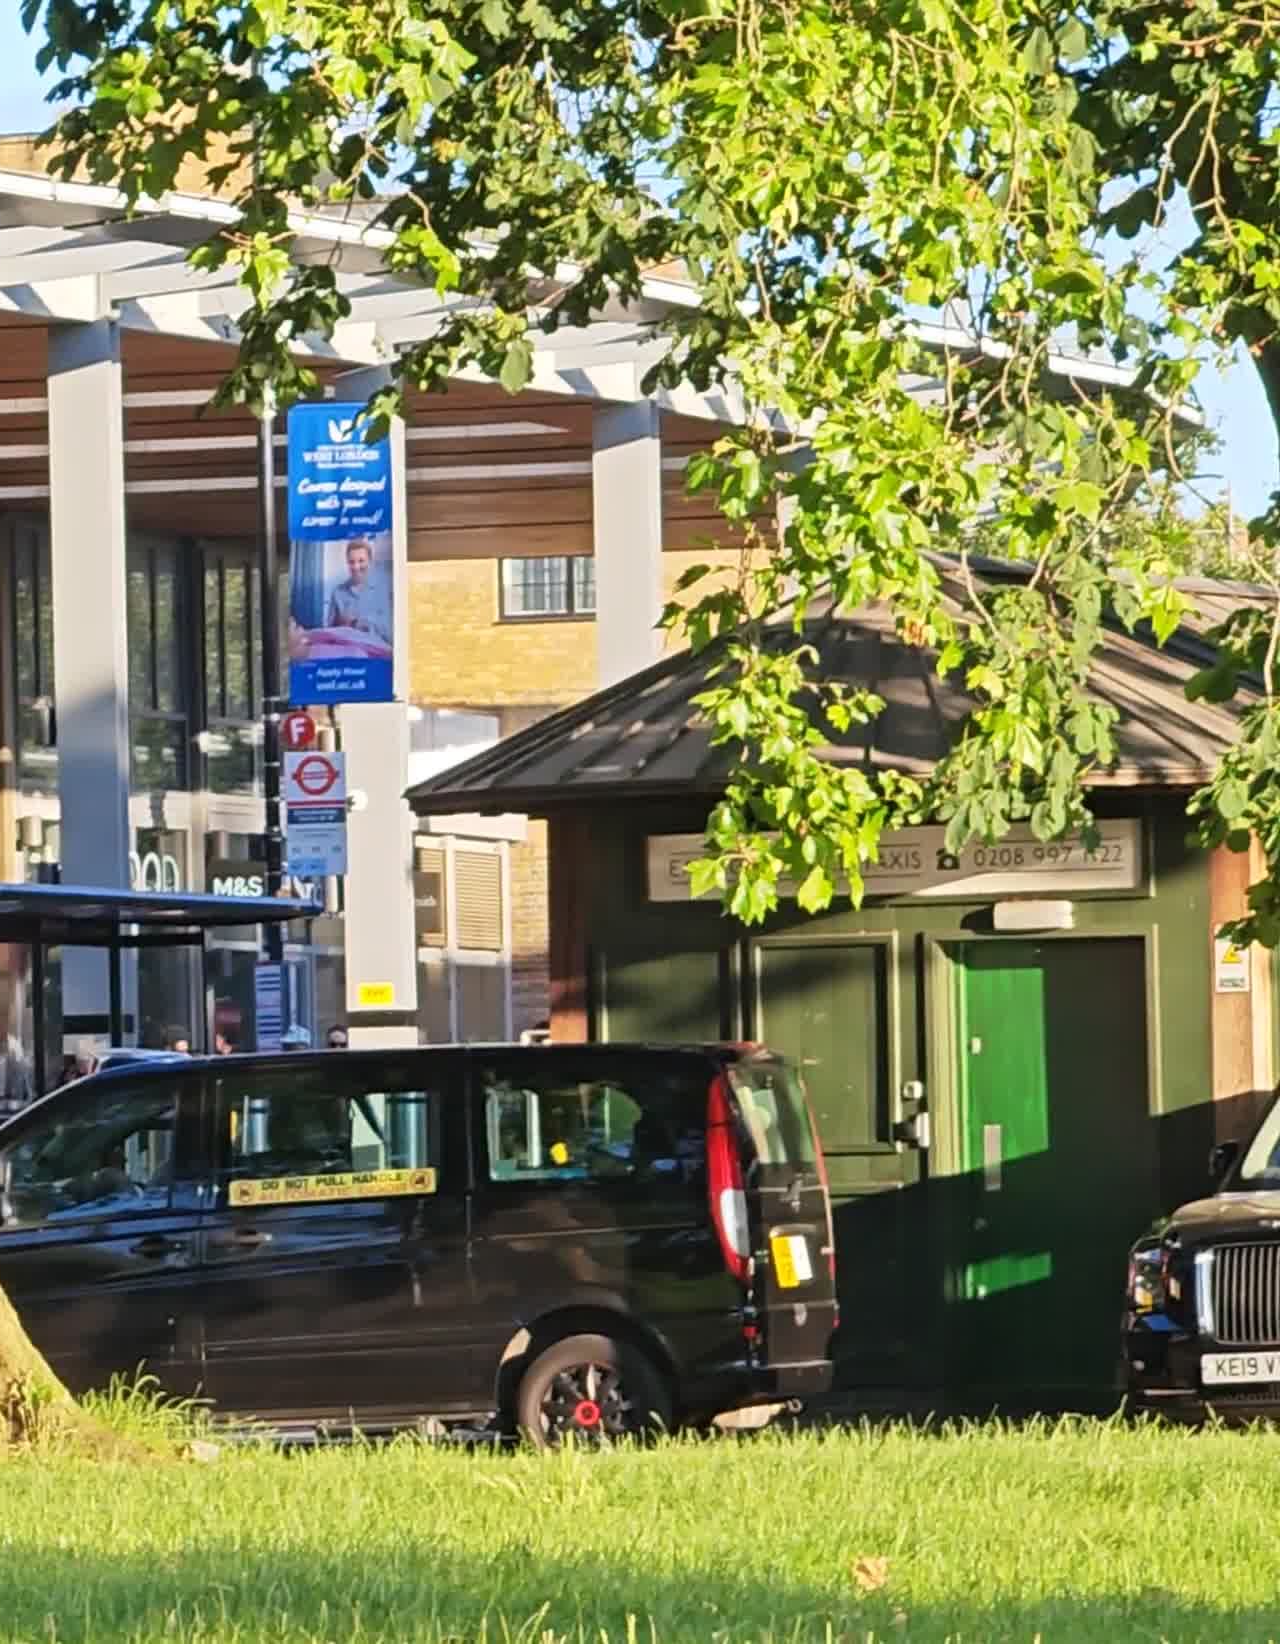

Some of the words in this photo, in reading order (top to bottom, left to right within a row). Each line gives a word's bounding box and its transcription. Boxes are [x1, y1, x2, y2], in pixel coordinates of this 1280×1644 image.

[290, 718, 306, 745] F
[973, 848, 1025, 867] 0208
[212, 875, 264, 897] M&S
[286, 1178, 309, 1189] NOT
[315, 1175, 344, 1187] PULL
[352, 1172, 402, 1185] HANDLE
[1216, 1357, 1258, 1377] KE19
